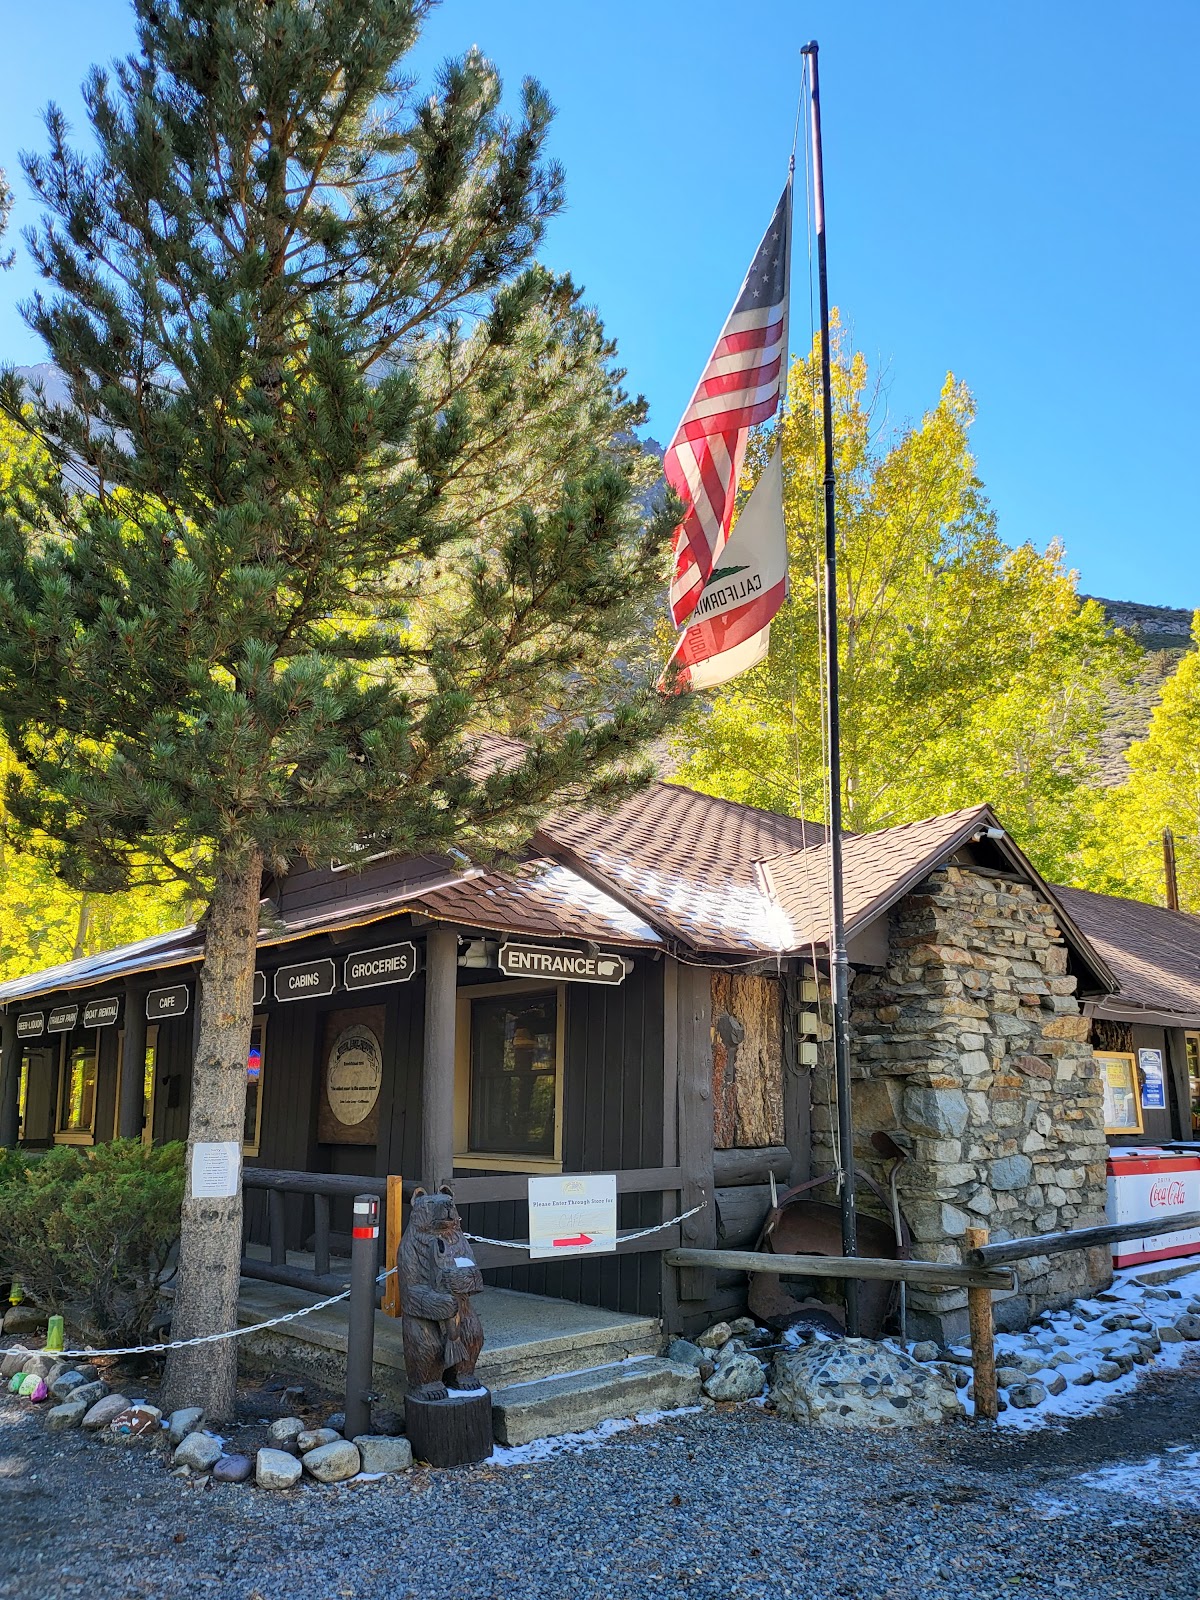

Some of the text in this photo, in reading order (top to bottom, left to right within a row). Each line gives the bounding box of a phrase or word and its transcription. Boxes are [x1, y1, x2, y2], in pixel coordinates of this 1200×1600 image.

[351, 955, 407, 978] GROCERIES
[508, 951, 596, 976] ENTRANCE
[288, 972, 320, 990] CABINS
[159, 995, 175, 1009] CAFE
[49, 1012, 78, 1025] TRAILER PARK
[85, 1006, 117, 1020] BOAT RENTAL
[1149, 1181, 1185, 1208] Coca-Cola
